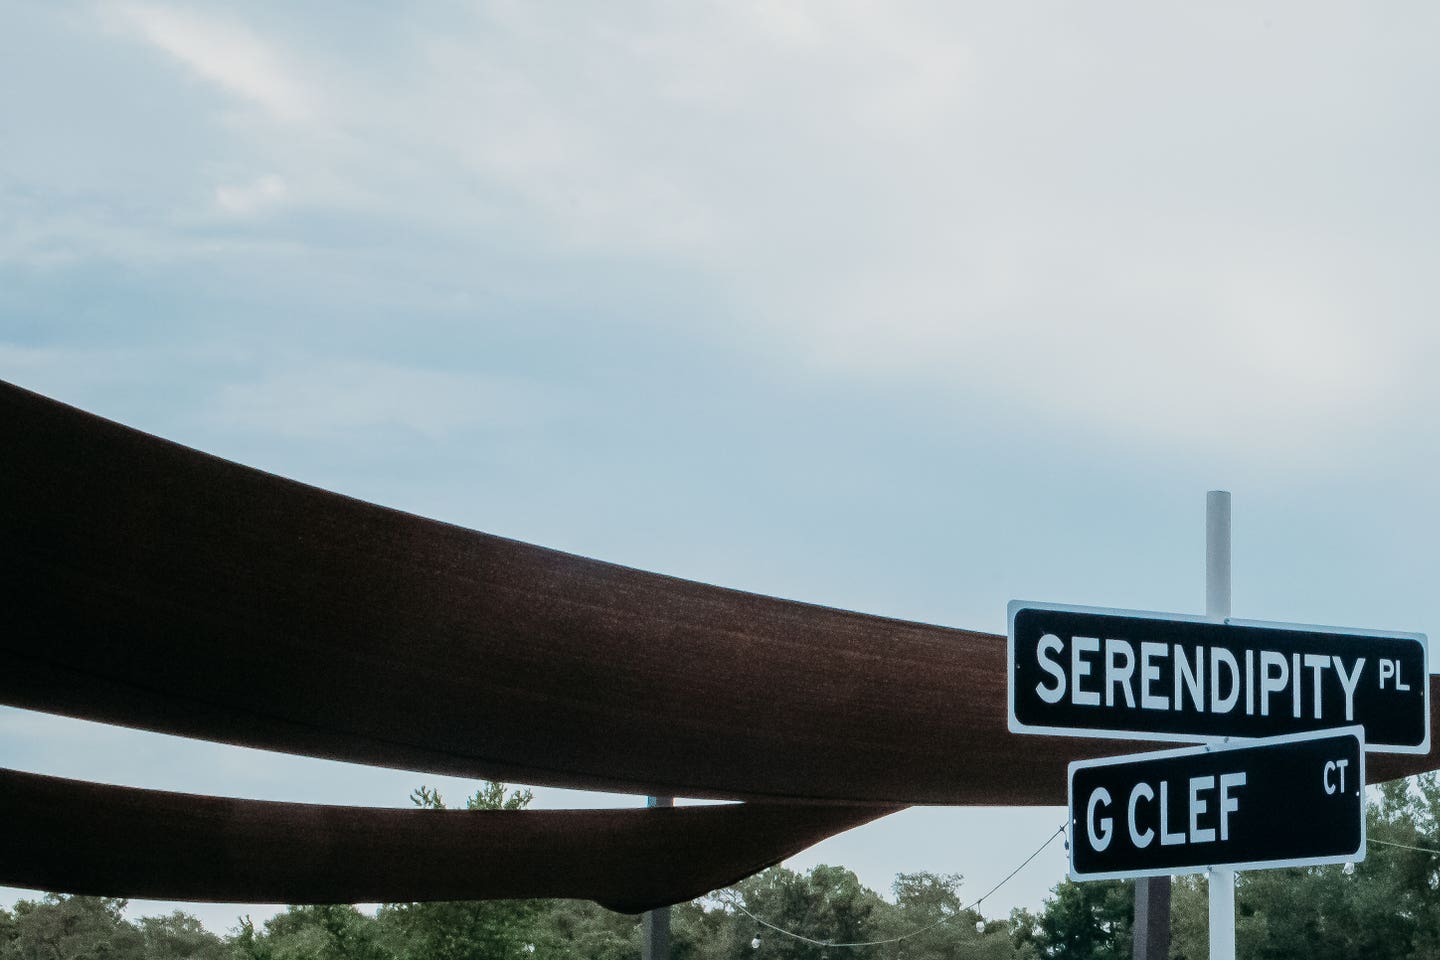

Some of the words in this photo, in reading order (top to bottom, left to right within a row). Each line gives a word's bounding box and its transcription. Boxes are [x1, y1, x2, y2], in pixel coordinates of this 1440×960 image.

[1035, 634, 1366, 721] SERENDIPITY
[1379, 659, 1410, 691] PL
[1087, 787, 1113, 852] G
[1128, 772, 1246, 849] CLEF
[1323, 759, 1348, 795] CT
